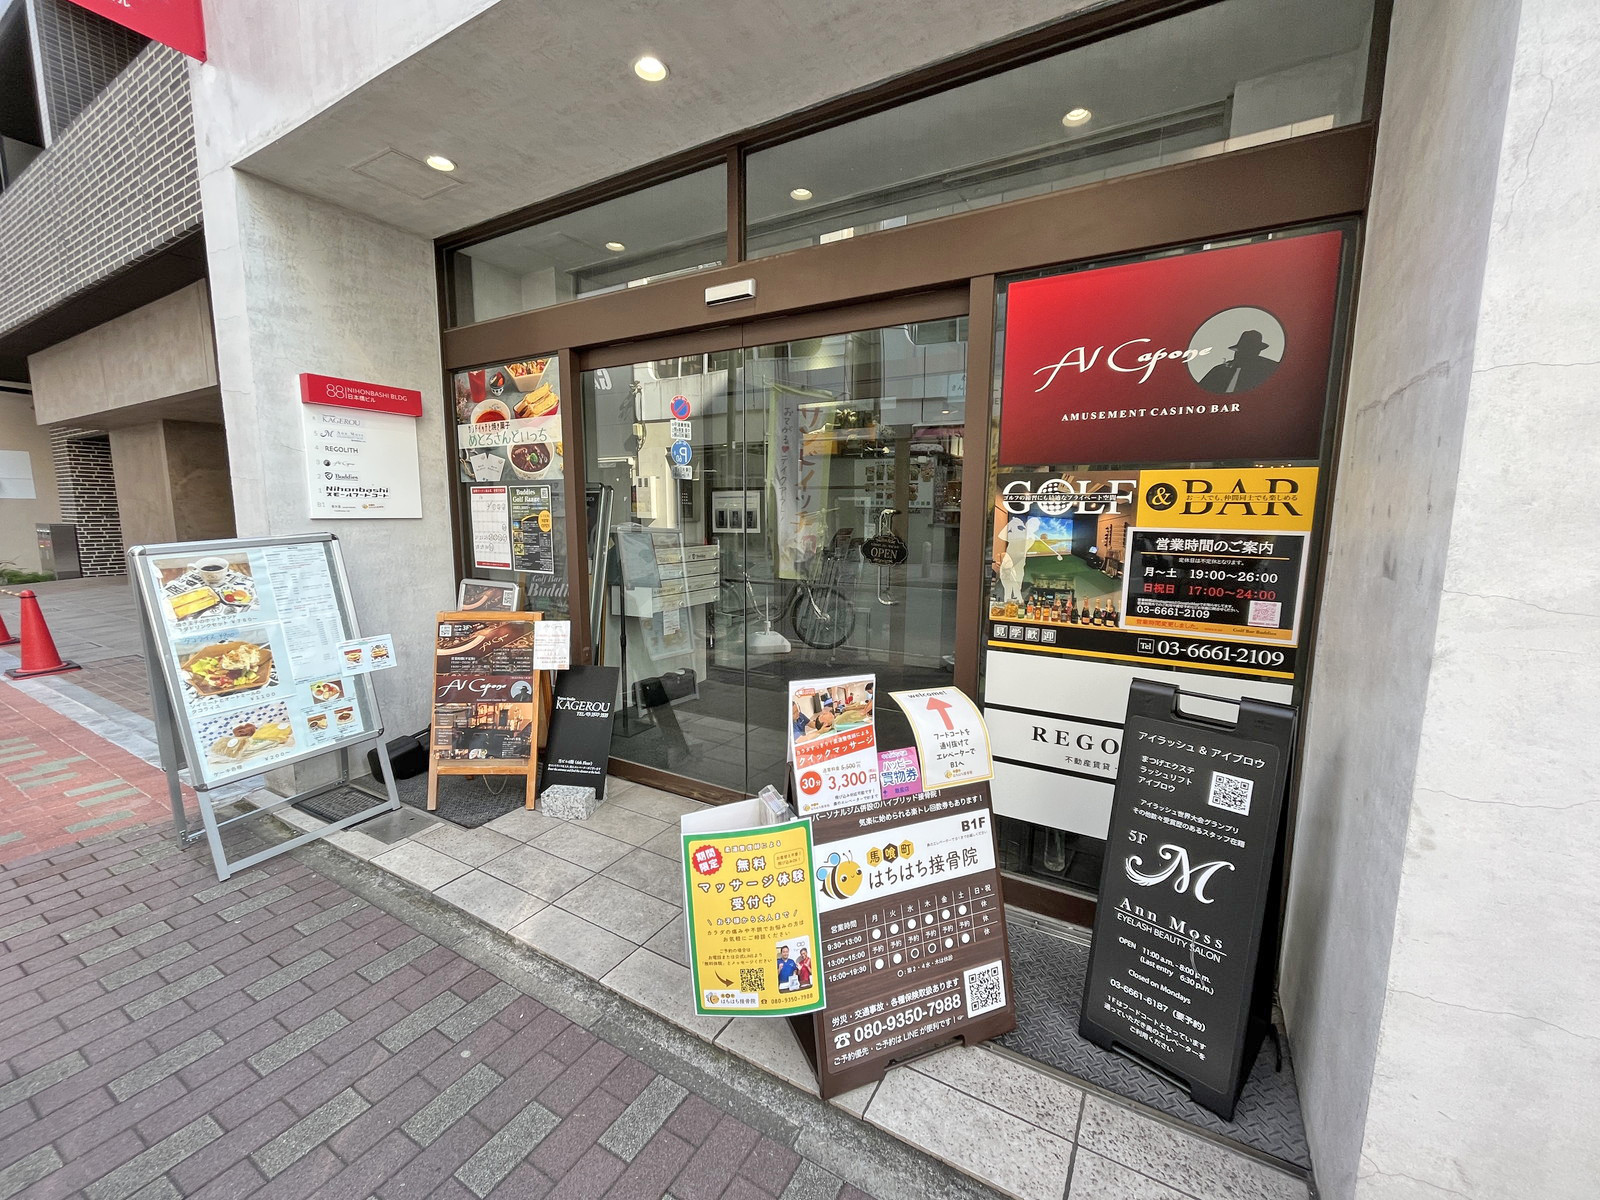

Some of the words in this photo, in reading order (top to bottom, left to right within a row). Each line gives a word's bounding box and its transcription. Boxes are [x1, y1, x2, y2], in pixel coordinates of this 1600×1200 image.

[1107, 338, 1213, 384] Capone
[326, 383, 345, 399] 88
[347, 387, 390, 399] NIHONBASHI
[390, 393, 408, 402] BLDG
[347, 393, 376, 403] 日本橋ビル
[1061, 408, 1147, 422] AMUSEMENT
[1150, 404, 1206, 417] CASINO
[1210, 403, 1241, 414] BAR
[324, 445, 359, 454] REGOLITH
[325, 485, 389, 494] Nihonbashi
[1002, 479, 1137, 515] GOLF
[1151, 486, 1173, 506] &
[1179, 478, 1303, 516] BAR
[870, 547, 898, 559] OPEN
[1155, 537, 1274, 555] 営業時間のご案内
[1143, 583, 1175, 594] 日祝日
[1136, 605, 1210, 619] 03-6661-2109
[995, 625, 1056, 642] 見学歓迎
[1140, 641, 1153, 651] Tel
[1157, 639, 1285, 668] 03-6661-2109
[555, 699, 610, 713] KAGEROU
[799, 734, 874, 766] クイックマッサージ
[939, 739, 969, 750] 通り抜けて
[1138, 730, 1196, 754] アイラッシュ
[1198, 745, 1208, 756] &
[1210, 748, 1267, 770] アイブロウ
[801, 777, 821, 790] 30分
[881, 767, 918, 787] 買物券
[1137, 775, 1177, 793] アイブロウ
[1138, 764, 1194, 786] ラッシュリフト
[961, 816, 986, 832] B1F
[1128, 829, 1148, 846] 5F
[695, 847, 717, 863] 期間
[868, 841, 914, 865] 馬喰町
[698, 858, 720, 873] 限定
[736, 856, 767, 873] 無料
[868, 847, 979, 890] はちはち接骨院
[698, 868, 805, 893] マッサージ体験
[731, 893, 776, 911] 受付中
[716, 911, 790, 926] お子様から大人まで
[830, 919, 858, 934] 営業時間
[1119, 897, 1158, 923] Ann
[1169, 915, 1224, 950] Moss
[1116, 912, 1153, 935] EYELASH
[1153, 925, 1188, 949] BEAUTY
[1188, 941, 1222, 964] SALON
[1118, 936, 1137, 950] OPEN
[1142, 947, 1160, 962] 11:00
[1160, 955, 1174, 968] a.m.
[1179, 964, 1195, 977] 8:00
[1139, 955, 1156, 969] (Last
[1156, 963, 1174, 978] entry
[1179, 974, 1195, 987] 6:30
[1109, 977, 1169, 1014] 03-6661-6187
[1128, 968, 1151, 986] Closed
[1150, 979, 1160, 990] on
[1160, 983, 1192, 1005] Mondays
[854, 994, 962, 1043] 080-9350-7988
[904, 1029, 919, 1041] LINE
